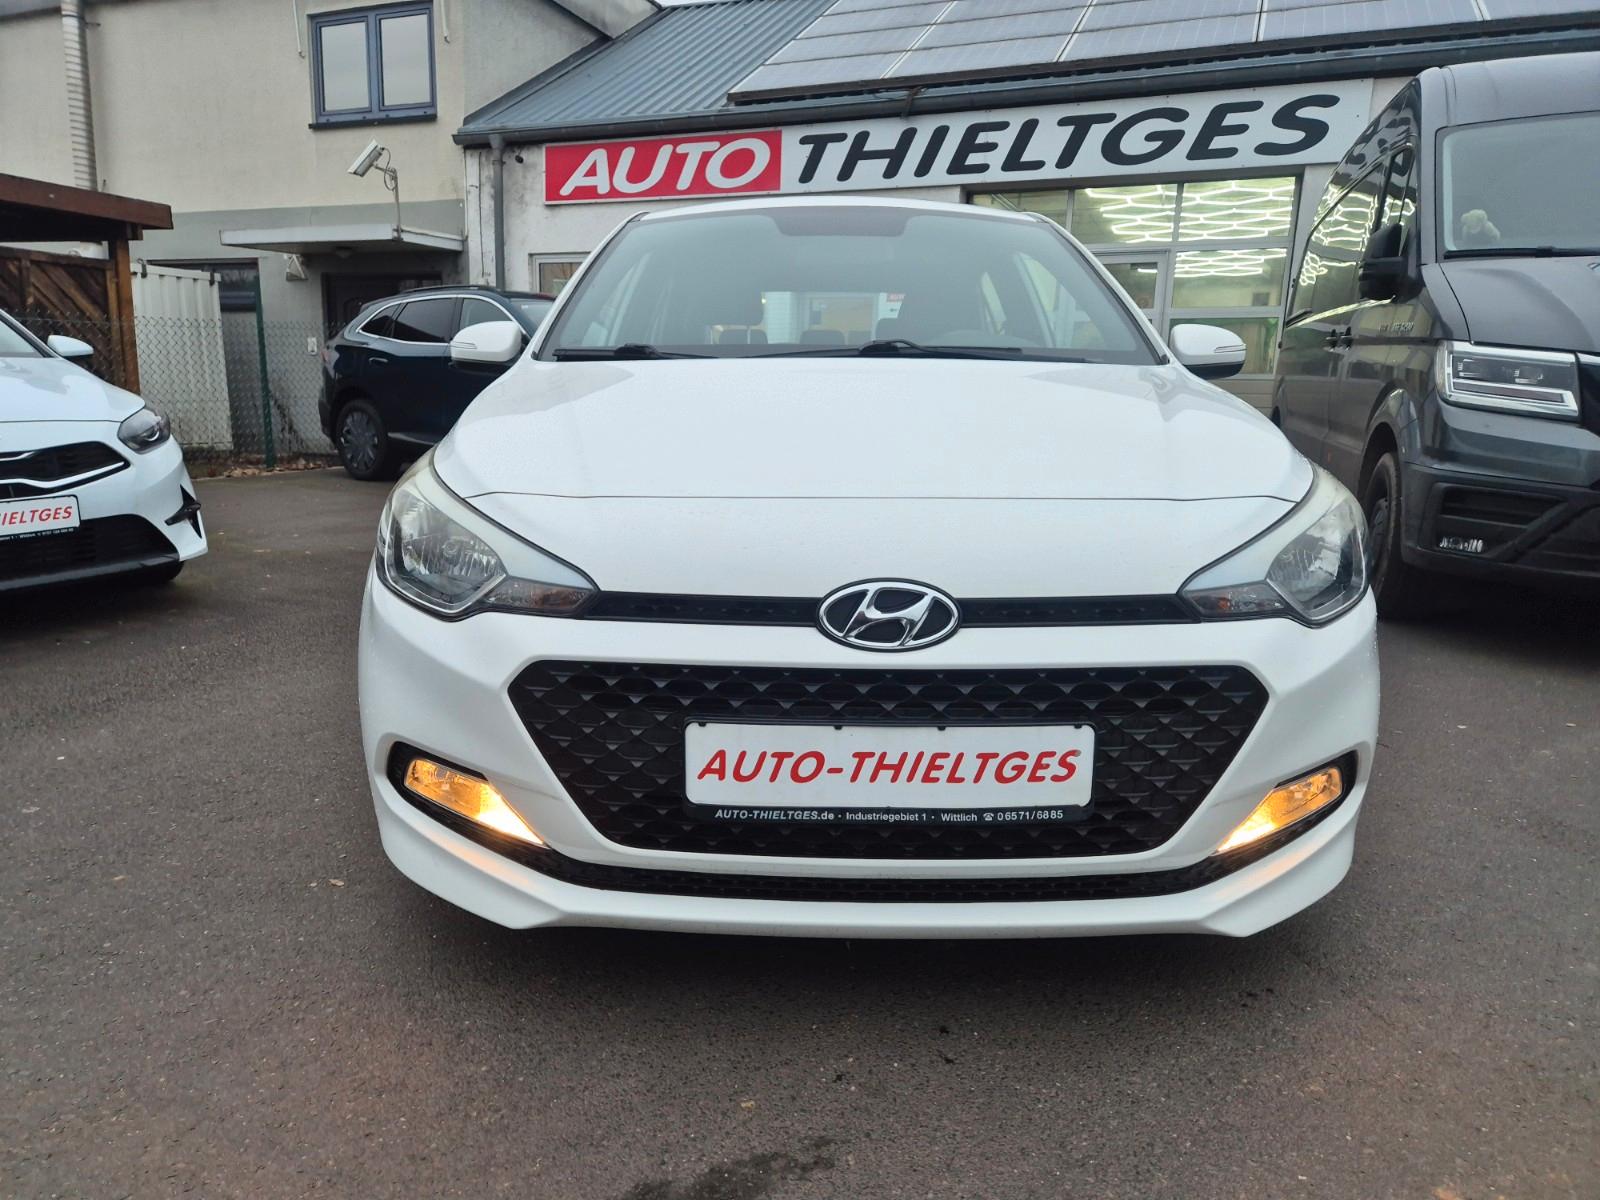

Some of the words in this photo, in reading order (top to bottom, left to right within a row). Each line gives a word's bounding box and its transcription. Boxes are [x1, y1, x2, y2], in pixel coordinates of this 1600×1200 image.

[559, 138, 771, 196] AUTO
[798, 94, 1341, 184] THIELTGES
[0, 506, 72, 526] IELTGES
[697, 749, 1082, 785] AUTO-THIELTGES
[715, 809, 834, 821] AUTO-THIELTGES.de
[846, 811, 919, 823] Industriegebiet
[941, 812, 978, 822] Wittlich
